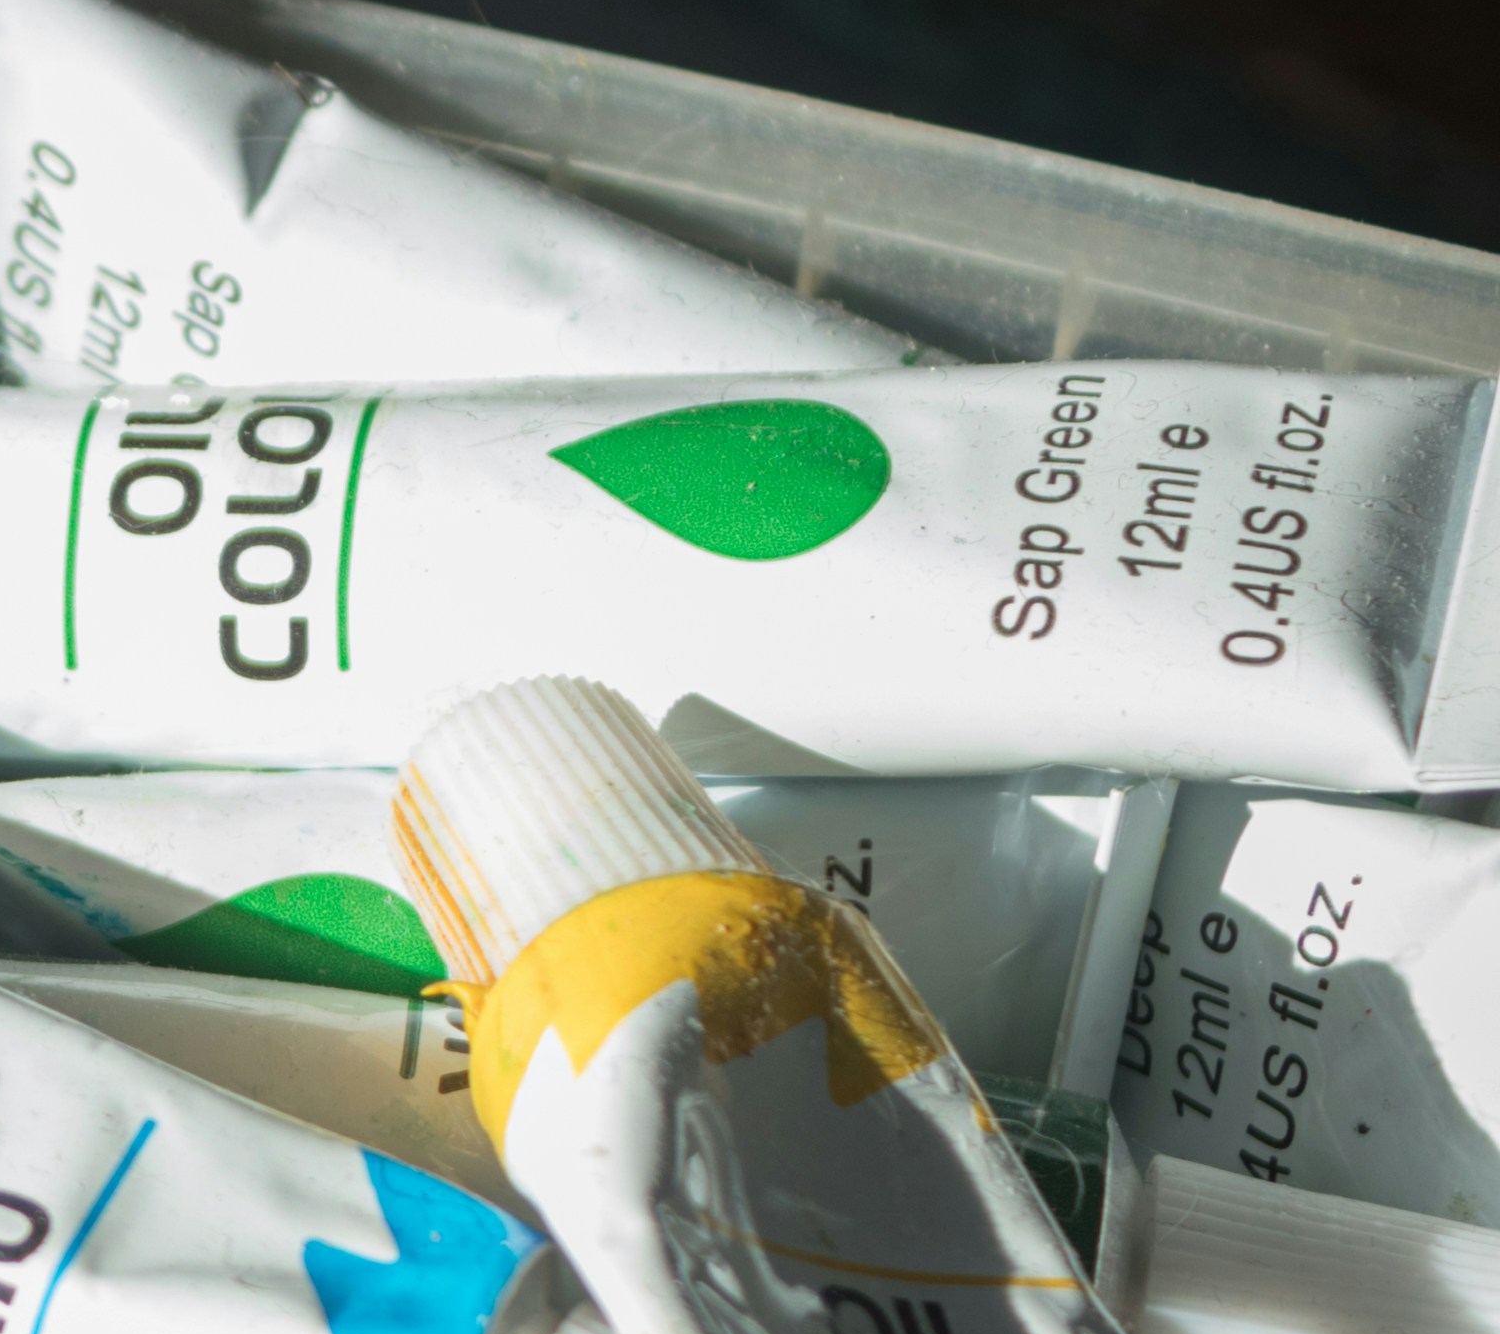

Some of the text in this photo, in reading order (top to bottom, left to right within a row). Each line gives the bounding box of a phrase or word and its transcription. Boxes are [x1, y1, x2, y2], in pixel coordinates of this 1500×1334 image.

[4, 139, 78, 309] 0.4US
[170, 258, 244, 359] Sap
[108, 395, 229, 536] OIL
[217, 394, 335, 682] COLO
[991, 372, 1107, 642] Sap Green
[1117, 421, 1211, 579] 12ml e
[1220, 393, 1335, 668] 0.4US fl.oz.
[1170, 908, 1240, 1121] 12ml e
[1267, 872, 1366, 1032] fl.oz.
